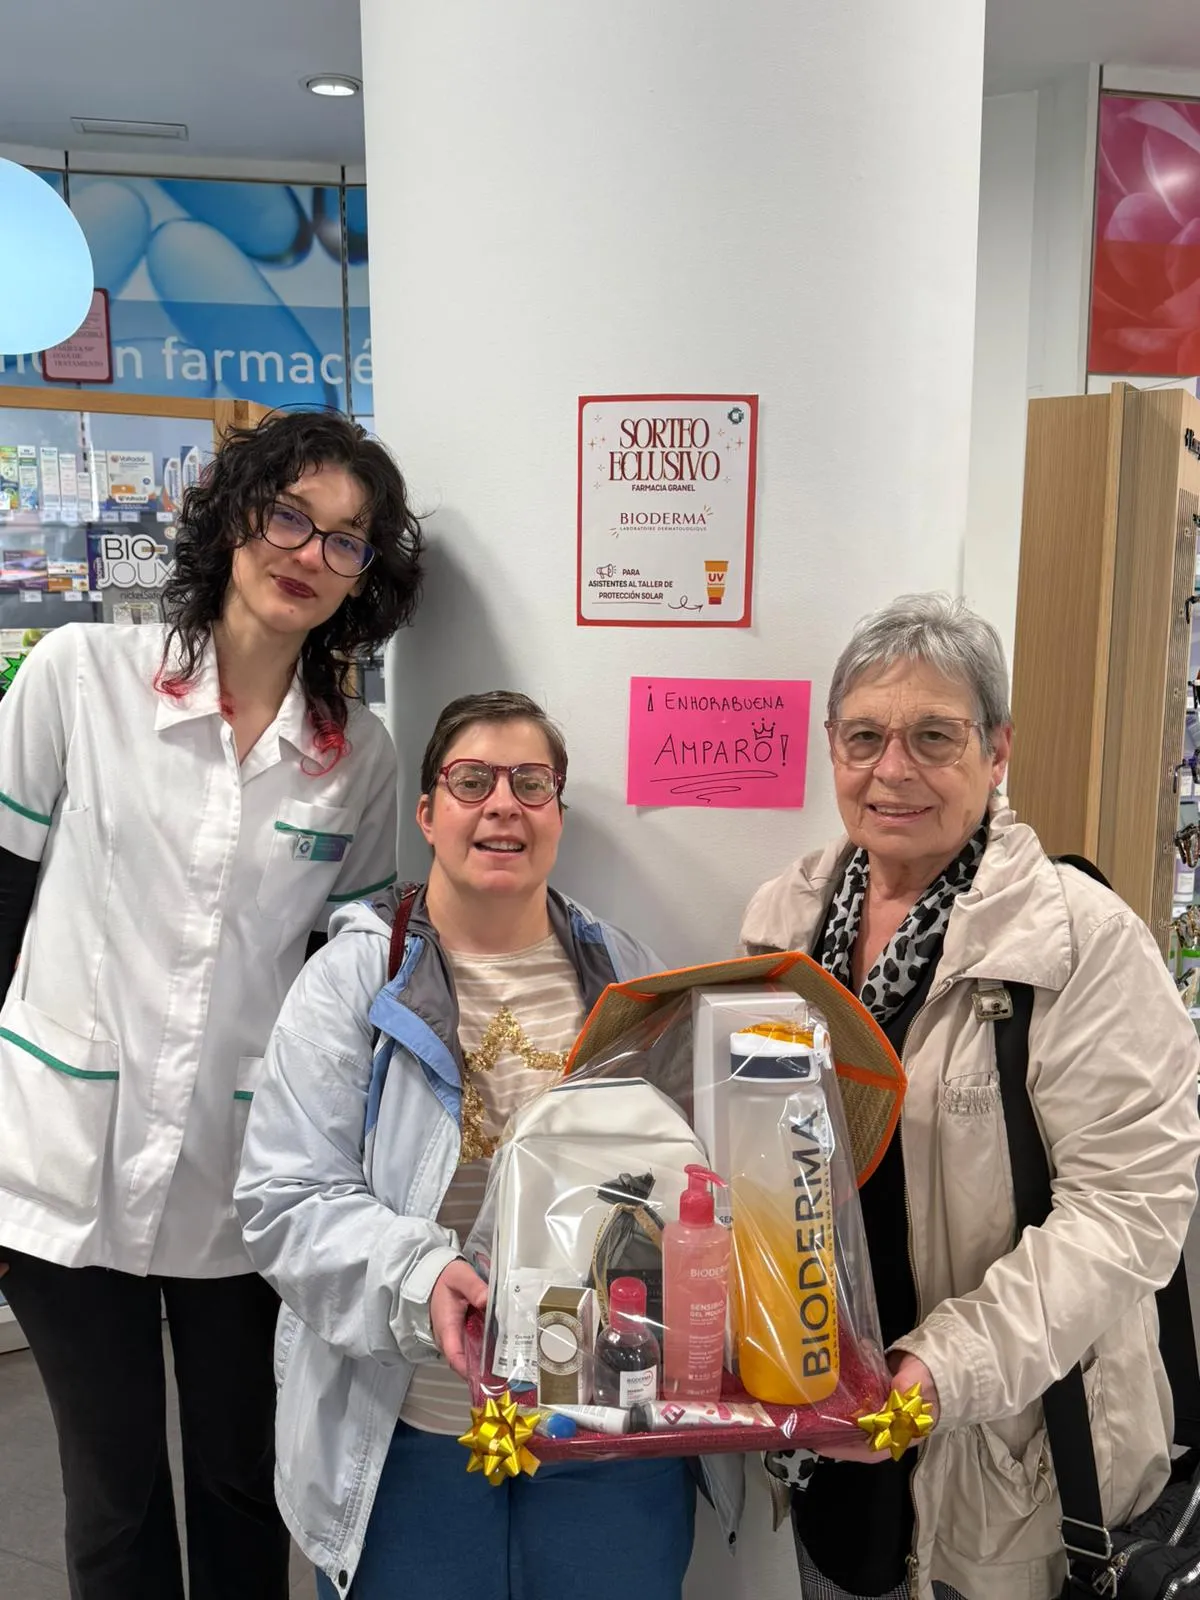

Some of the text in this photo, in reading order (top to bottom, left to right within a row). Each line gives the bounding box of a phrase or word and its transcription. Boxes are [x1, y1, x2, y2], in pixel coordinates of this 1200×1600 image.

[620, 417, 710, 449] SORTEO
[609, 450, 720, 481] ECLUSIVO
[632, 484, 696, 492] FARMACIA GRANEL
[620, 512, 707, 525] BIODERMA
[622, 568, 641, 576] PARA
[708, 573, 724, 582] UV
[588, 580, 674, 588] ASISTENTES AL TALLER DE
[598, 590, 664, 600] PROTECCIÓN SOLAR
[665, 692, 785, 712] ENHORABUENA
[790, 1108, 832, 1378] BIODERMA
